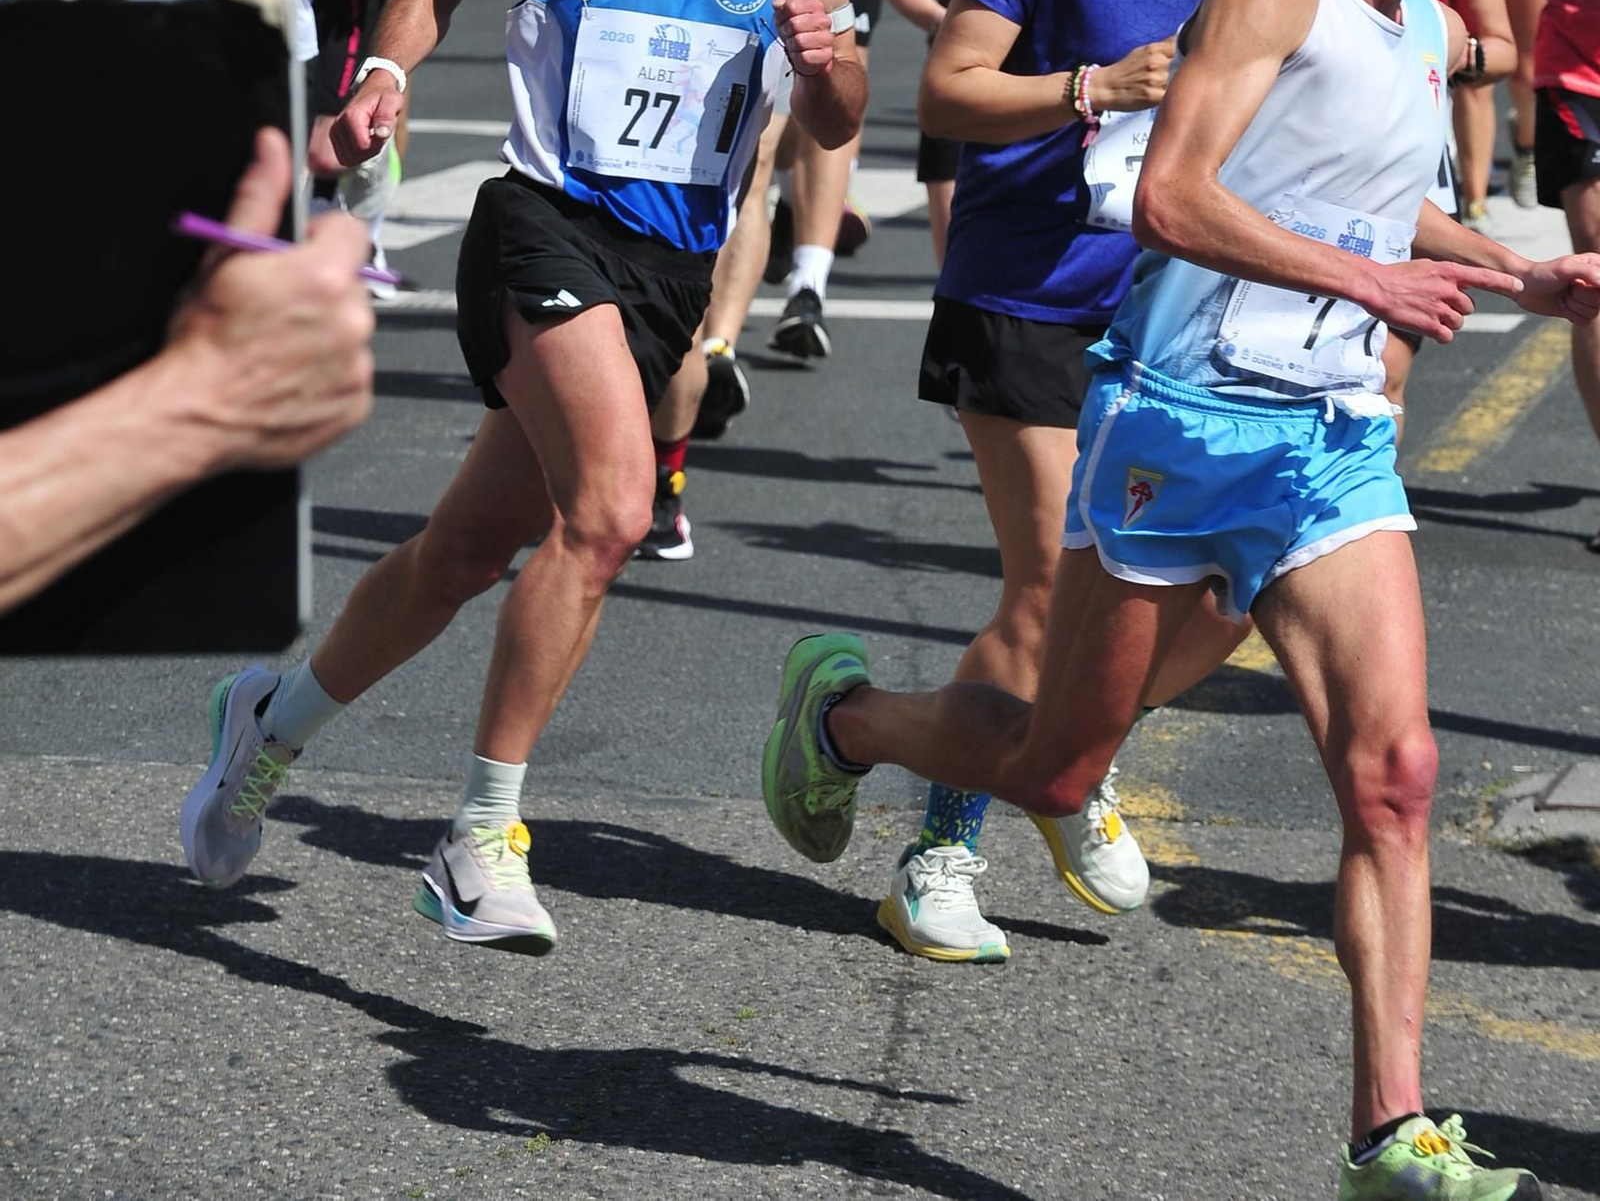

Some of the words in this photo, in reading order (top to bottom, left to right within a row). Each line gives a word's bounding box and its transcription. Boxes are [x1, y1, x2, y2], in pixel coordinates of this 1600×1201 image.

[599, 30, 635, 44] 2026
[637, 66, 676, 84] ALBI
[617, 87, 681, 150] 27
[1291, 220, 1328, 240] 2026
